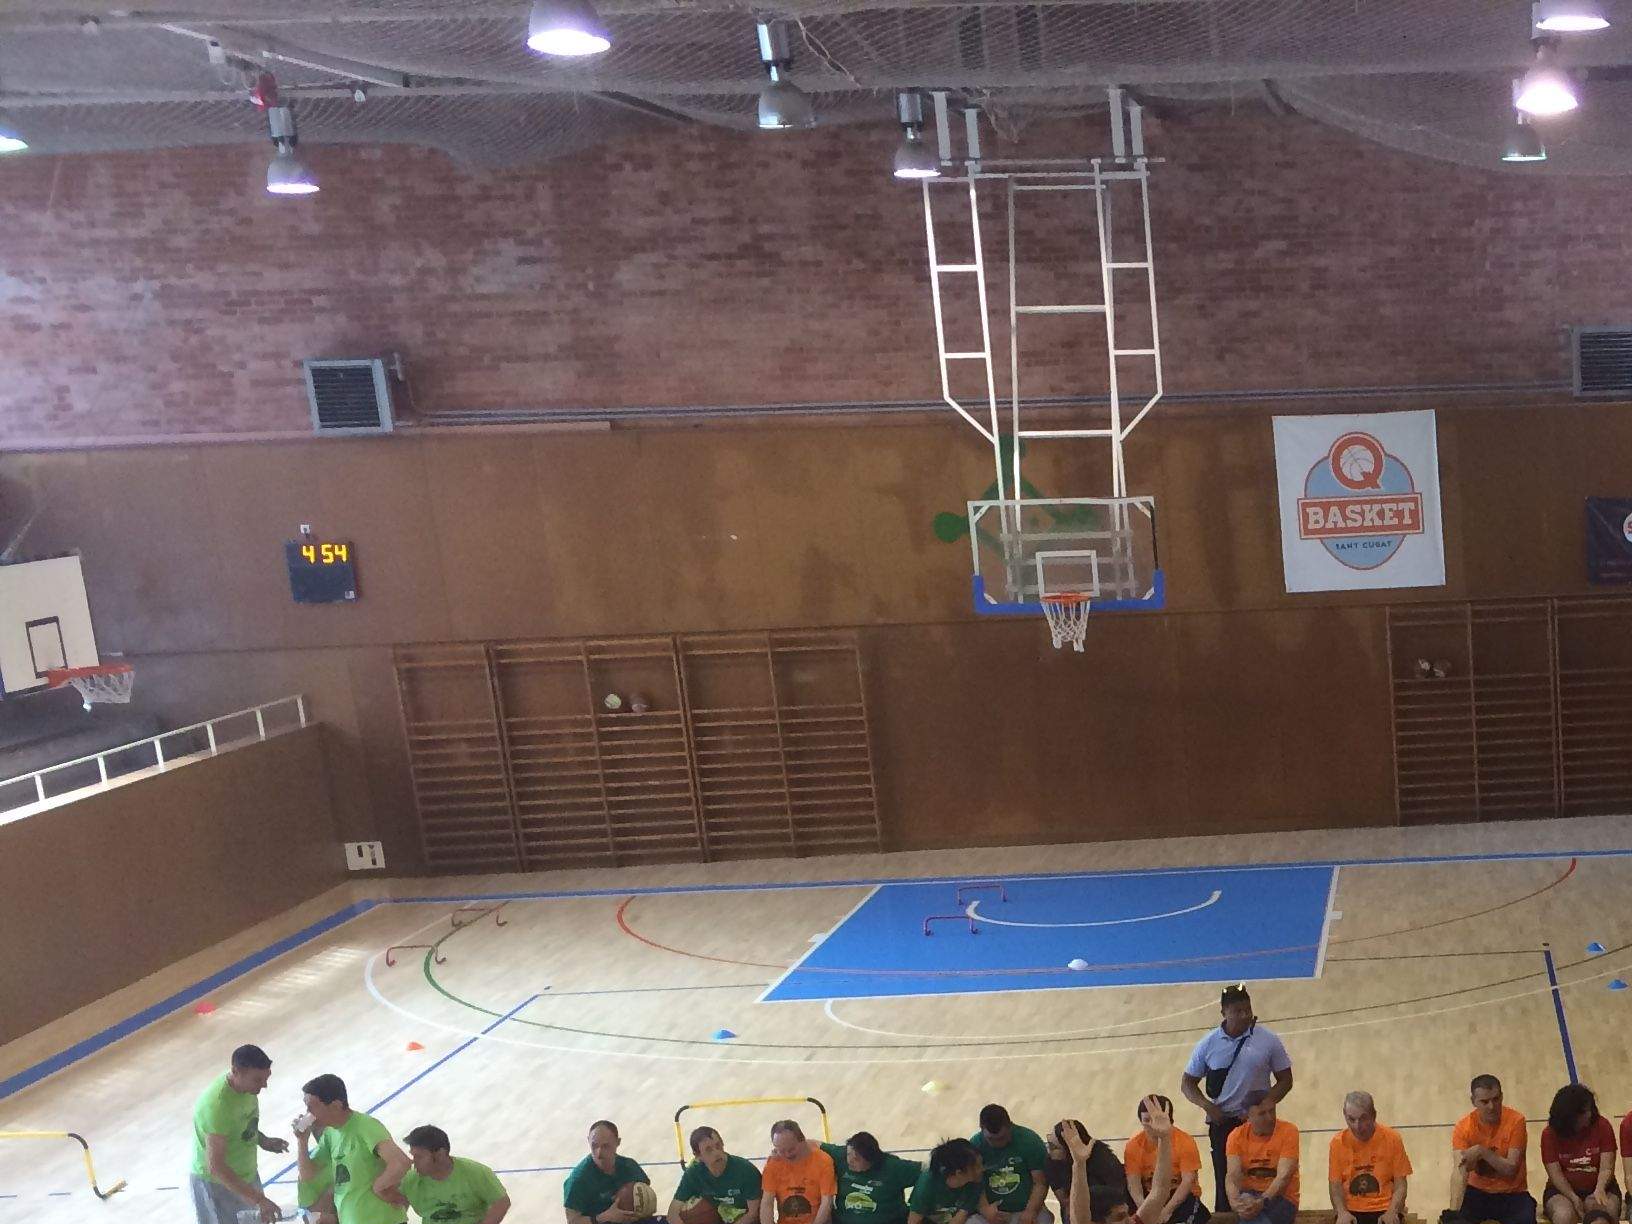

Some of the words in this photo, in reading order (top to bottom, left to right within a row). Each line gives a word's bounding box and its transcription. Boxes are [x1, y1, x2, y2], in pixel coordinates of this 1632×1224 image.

[1332, 436, 1383, 490] Q
[1306, 502, 1415, 529] BASKET
[1336, 542, 1358, 550] SANT
[1363, 541, 1392, 549] CUGAT
